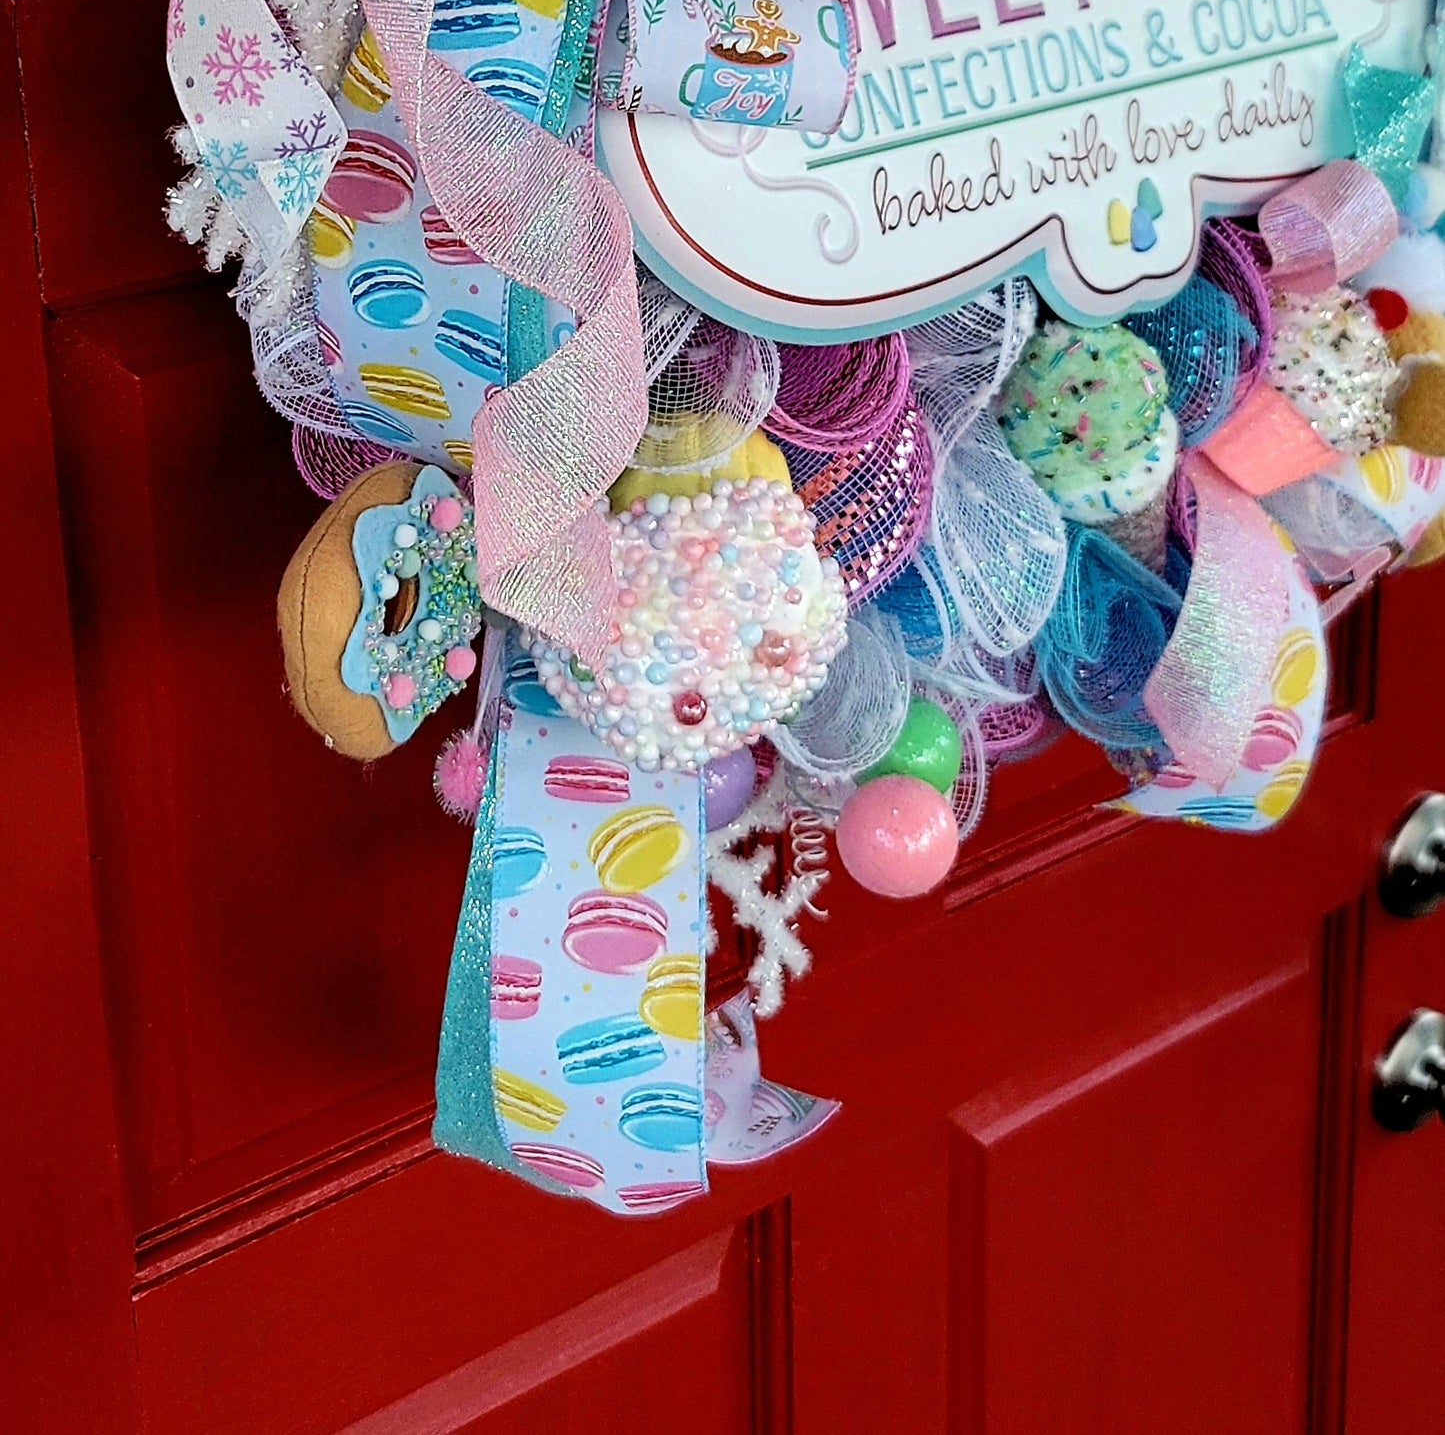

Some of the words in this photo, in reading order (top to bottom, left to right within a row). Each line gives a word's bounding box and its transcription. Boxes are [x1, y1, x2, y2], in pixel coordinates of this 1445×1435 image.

[1147, 10, 1183, 67] &
[706, 68, 775, 119] Joy
[873, 138, 1014, 235] baked
[1028, 114, 1117, 187] with
[1127, 98, 1205, 164] love
[1218, 61, 1315, 147] daily
